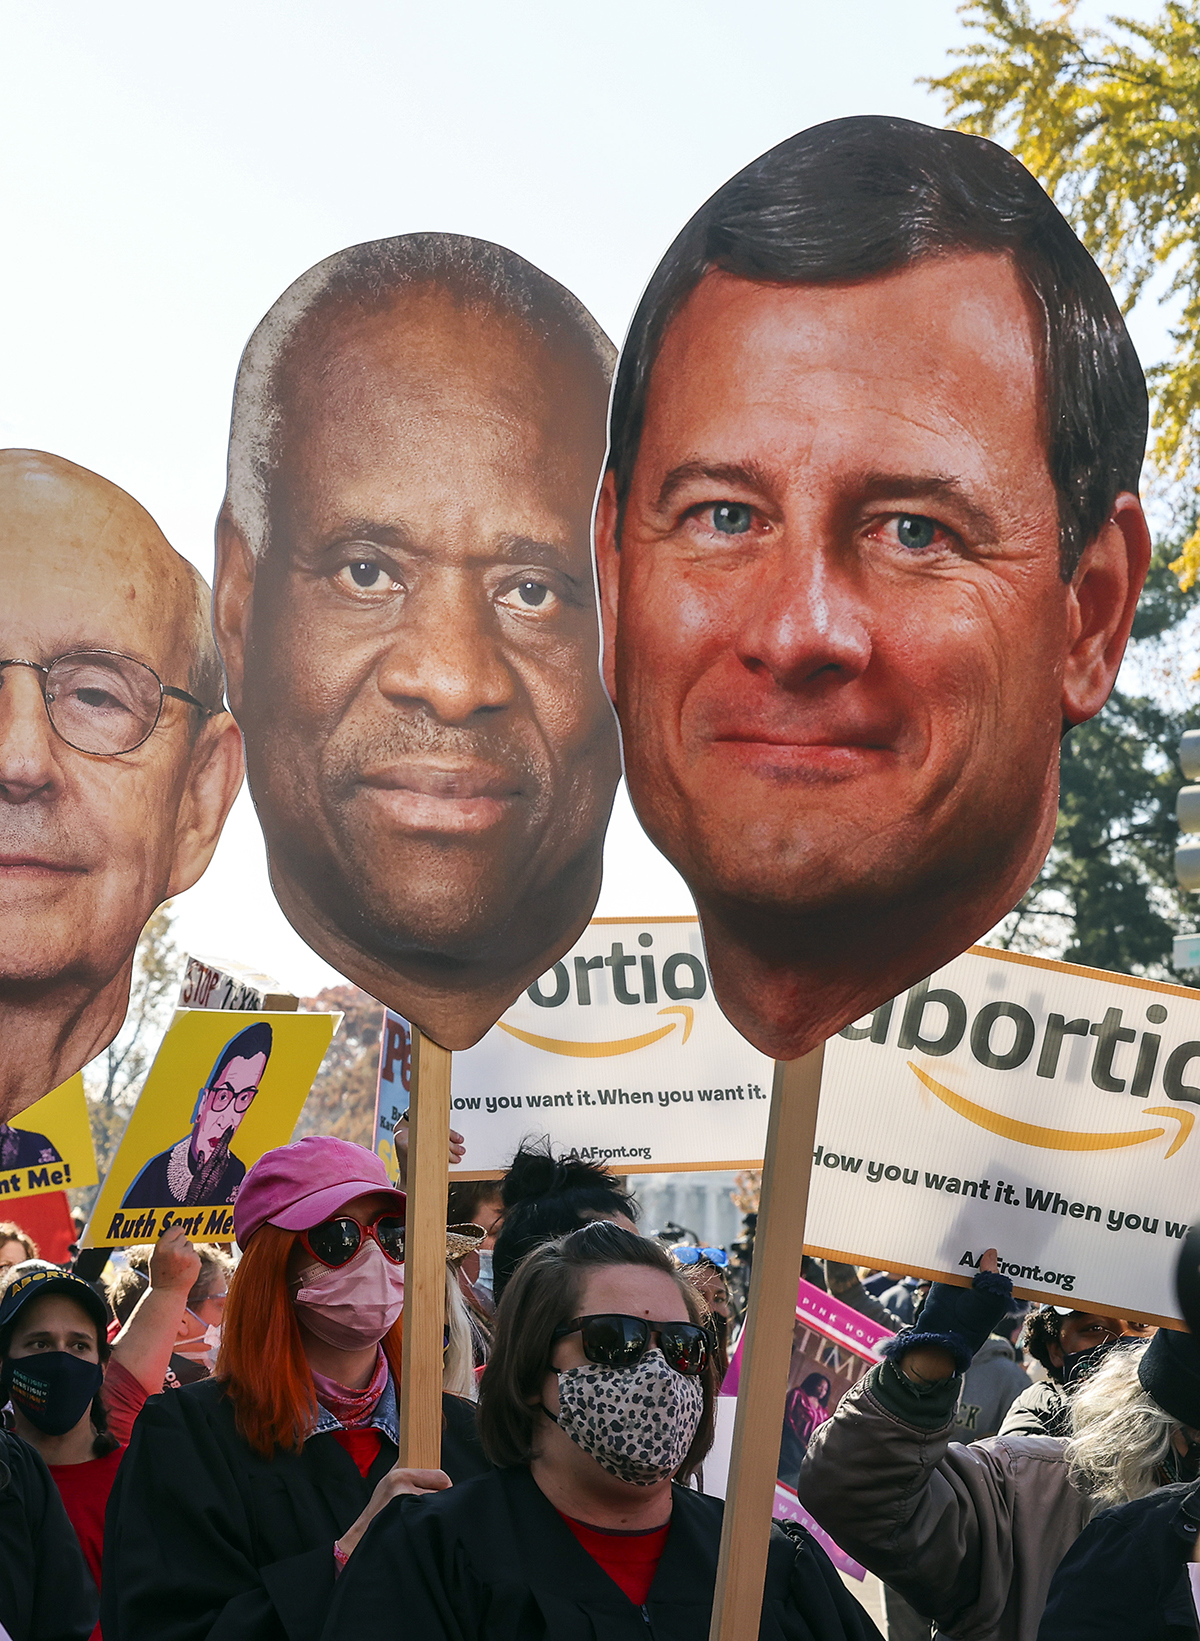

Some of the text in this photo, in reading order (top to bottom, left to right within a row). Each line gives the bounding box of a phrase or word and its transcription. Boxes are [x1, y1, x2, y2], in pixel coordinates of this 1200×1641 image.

[183, 960, 220, 1008] STOP
[510, 932, 707, 1008] ortio
[836, 975, 1200, 1106] abortio
[450, 1083, 768, 1114] ow you want it. When you want it.
[570, 1146, 652, 1160] AAFront.org
[28, 1164, 72, 1190] Me!
[866, 1161, 919, 1184] you
[925, 1172, 991, 1200] want
[994, 1180, 1020, 1206] it.
[1025, 1187, 1102, 1223] When
[1106, 1209, 1160, 1235] you
[106, 1209, 157, 1239] Ruth
[802, 1297, 874, 1344] PINK HOU
